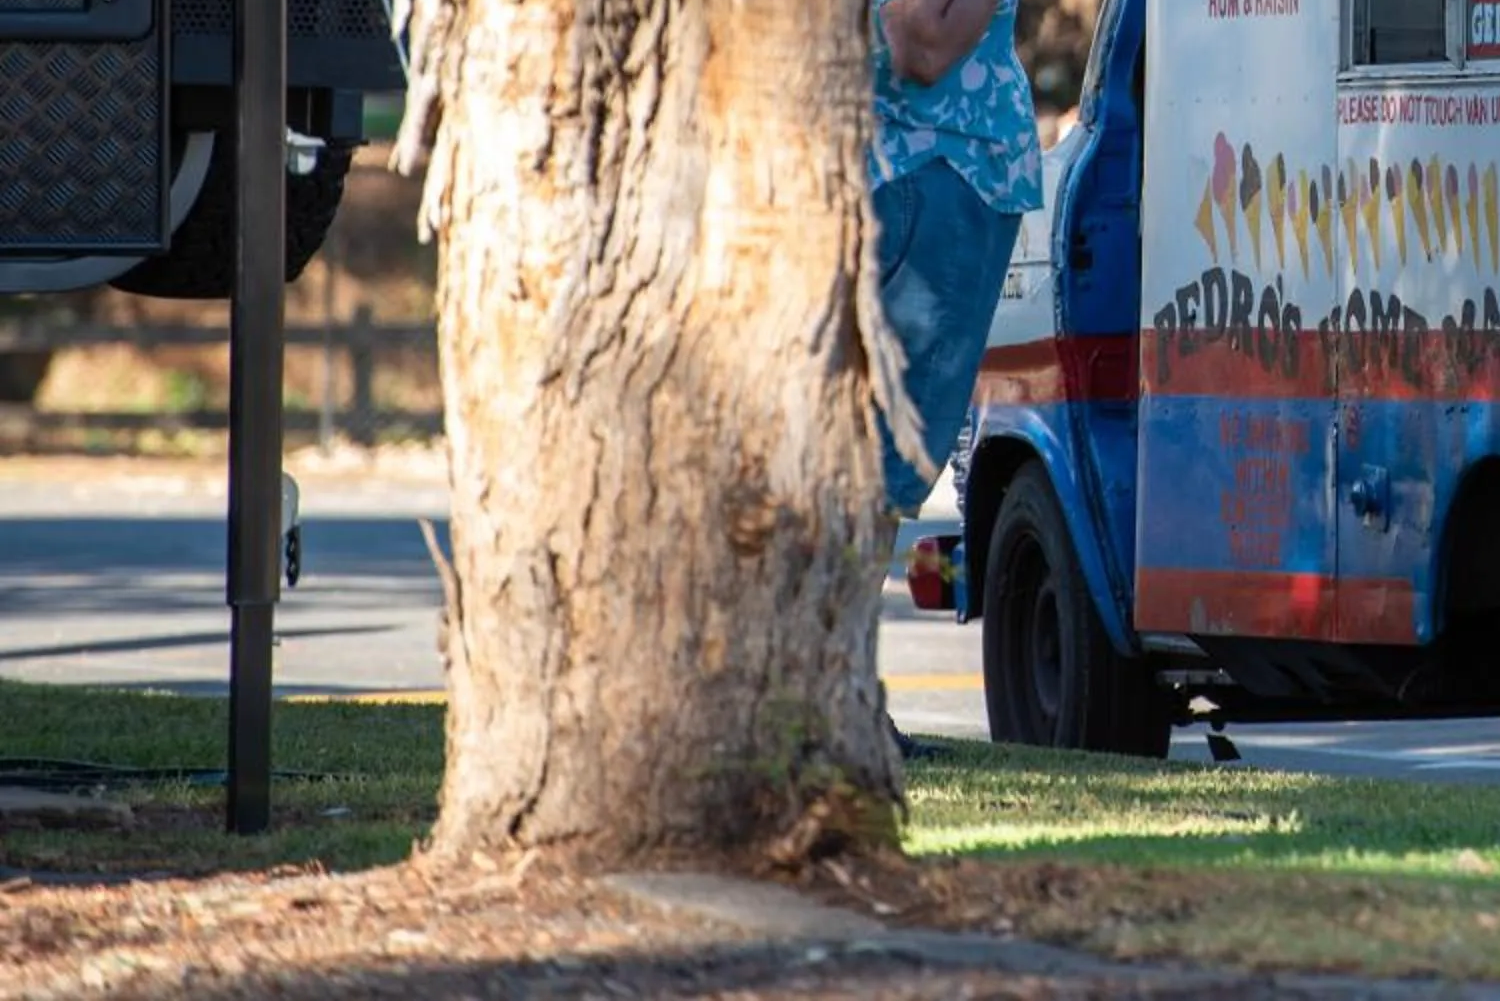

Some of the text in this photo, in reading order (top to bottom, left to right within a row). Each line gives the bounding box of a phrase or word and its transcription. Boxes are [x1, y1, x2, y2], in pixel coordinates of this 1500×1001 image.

[1338, 94, 1378, 124] PLEASE
[1399, 95, 1422, 123] NOT
[1424, 95, 1463, 126] TOUCH
